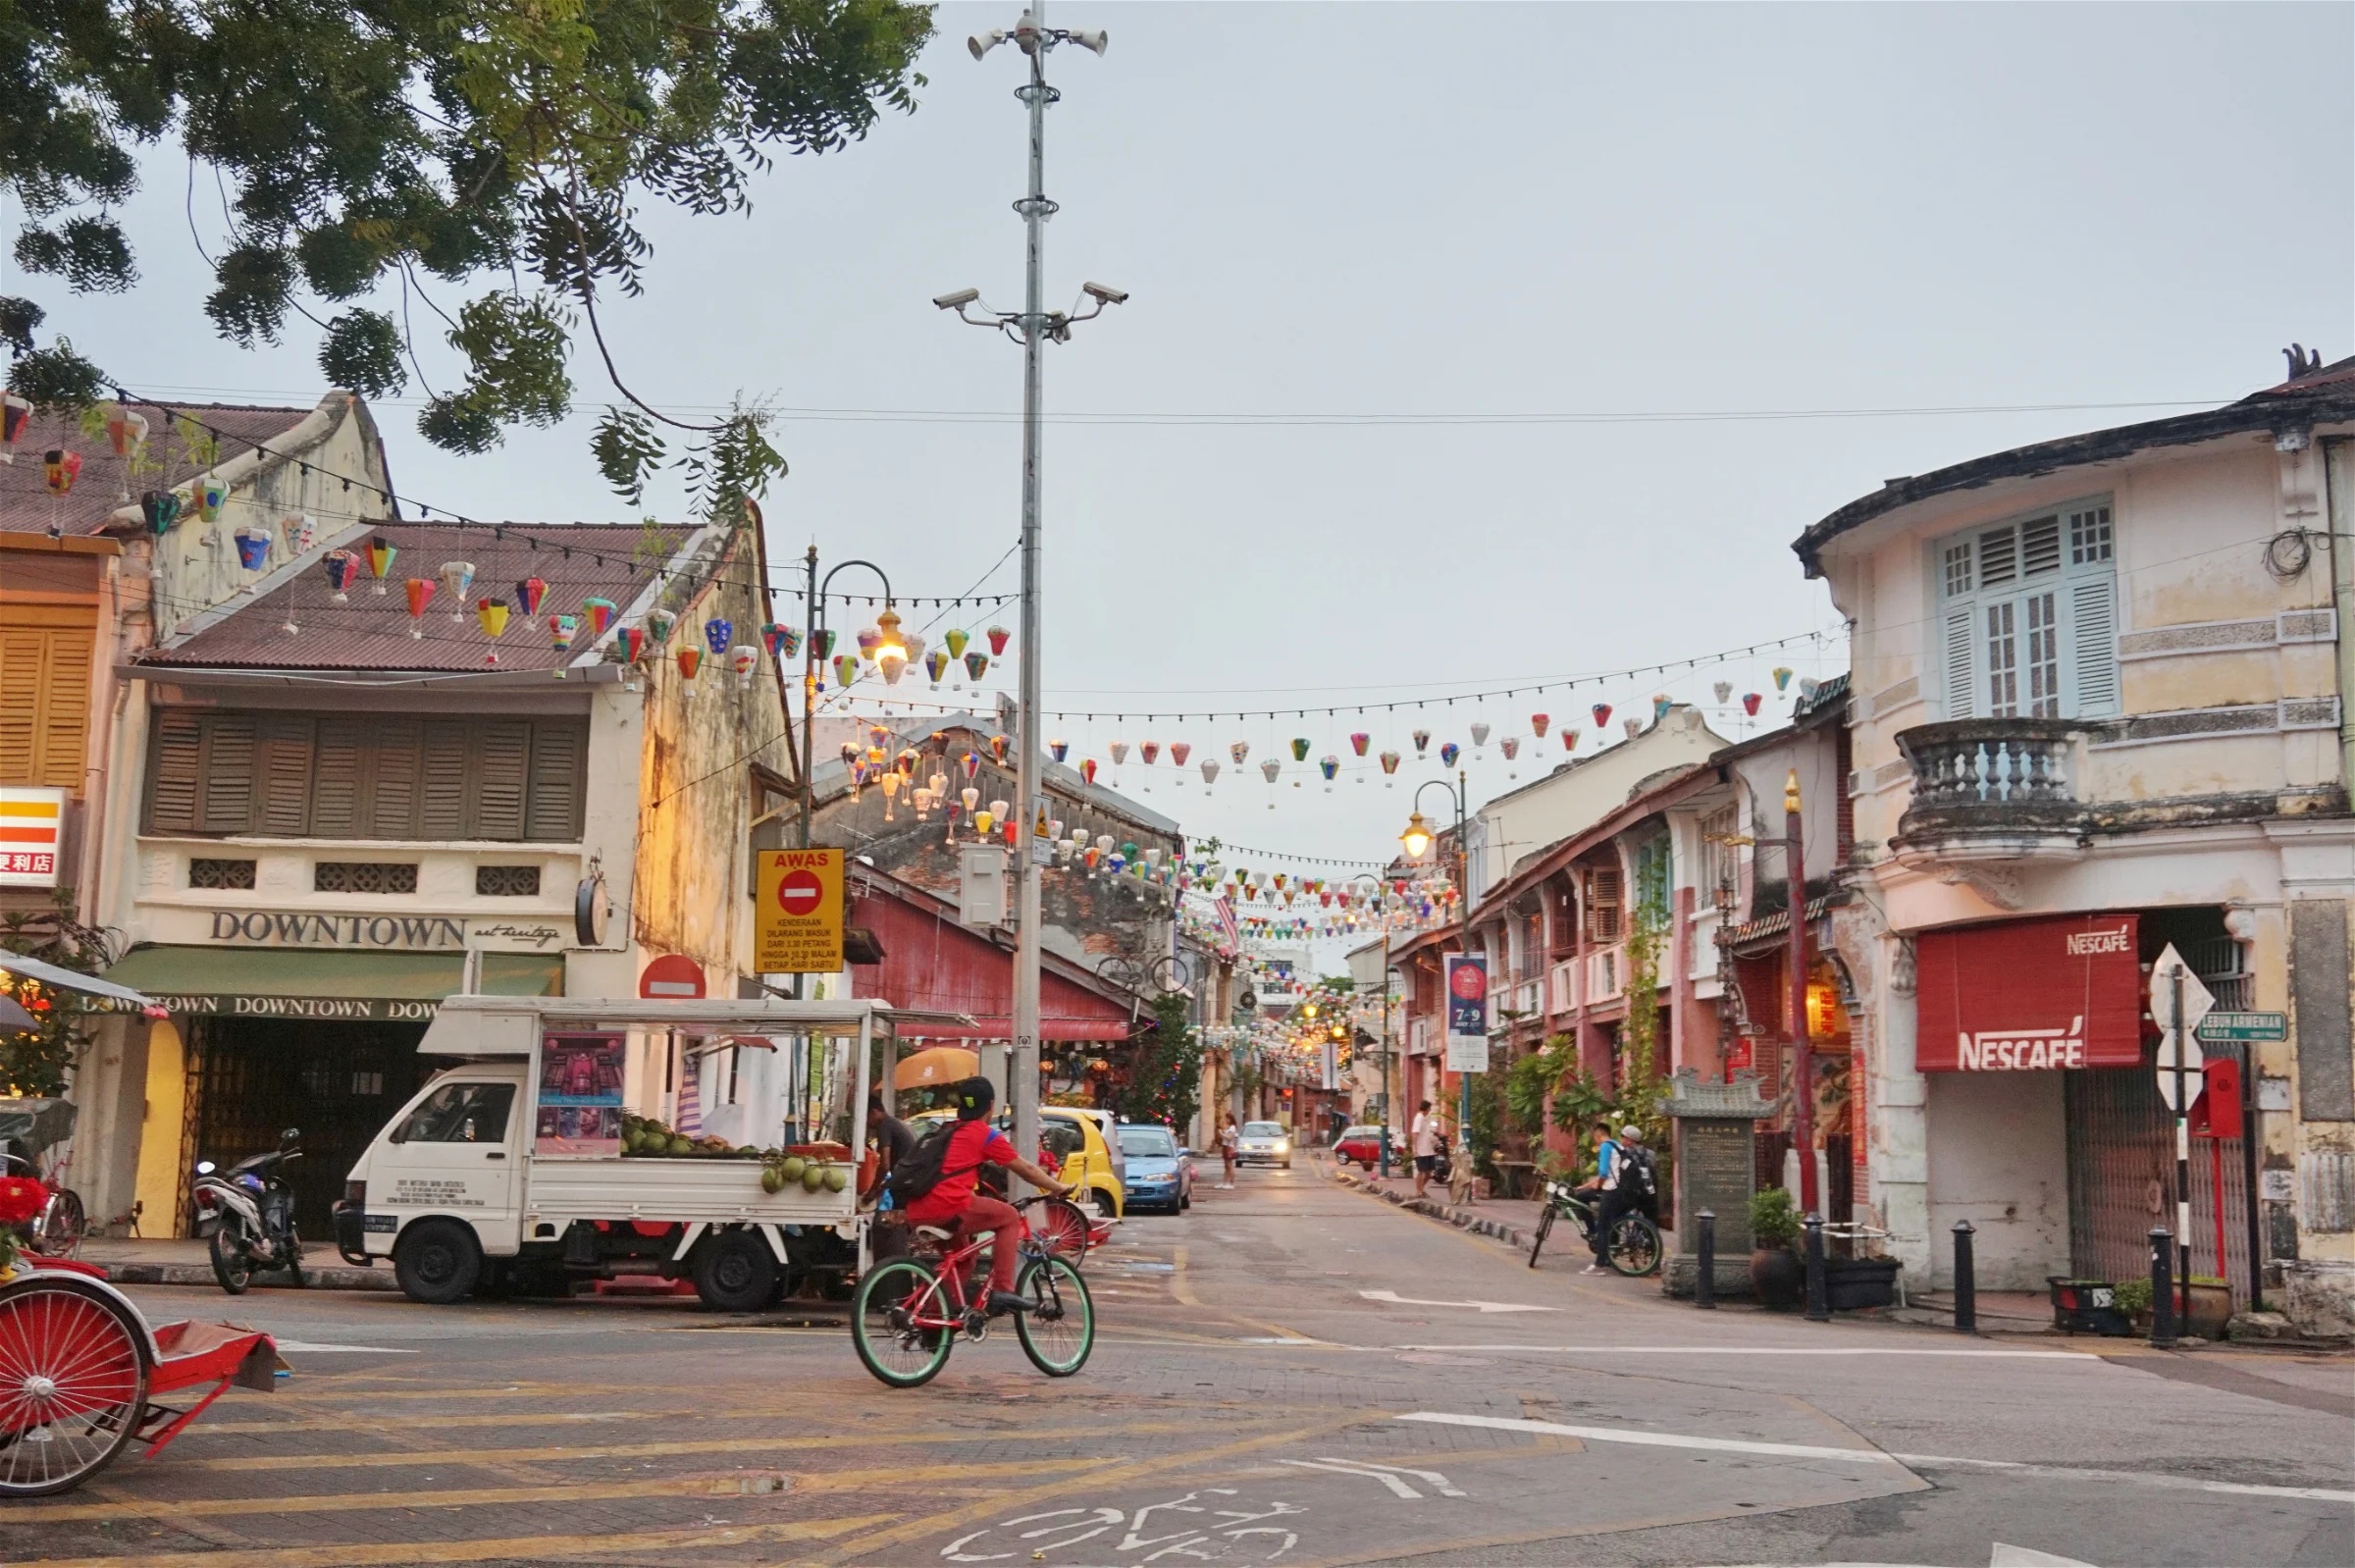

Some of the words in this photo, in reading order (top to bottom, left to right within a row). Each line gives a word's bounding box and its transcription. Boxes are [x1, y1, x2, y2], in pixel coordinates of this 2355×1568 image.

[774, 853, 829, 867] AWAS
[210, 911, 469, 947] DOWNTOWN
[475, 924, 502, 936] art
[501, 925, 560, 948] heritage
[806, 928, 831, 937] MASUK
[803, 939, 831, 948] PETANG
[2067, 923, 2129, 955] NESCAFÉ
[763, 961, 789, 969] SETIAP
[235, 997, 373, 1018] DOWNTOWN
[2202, 1015, 2231, 1028] LEBUH
[2231, 1015, 2282, 1028] ARMENIAN
[1958, 1015, 2083, 1071] NESCAFÉ
